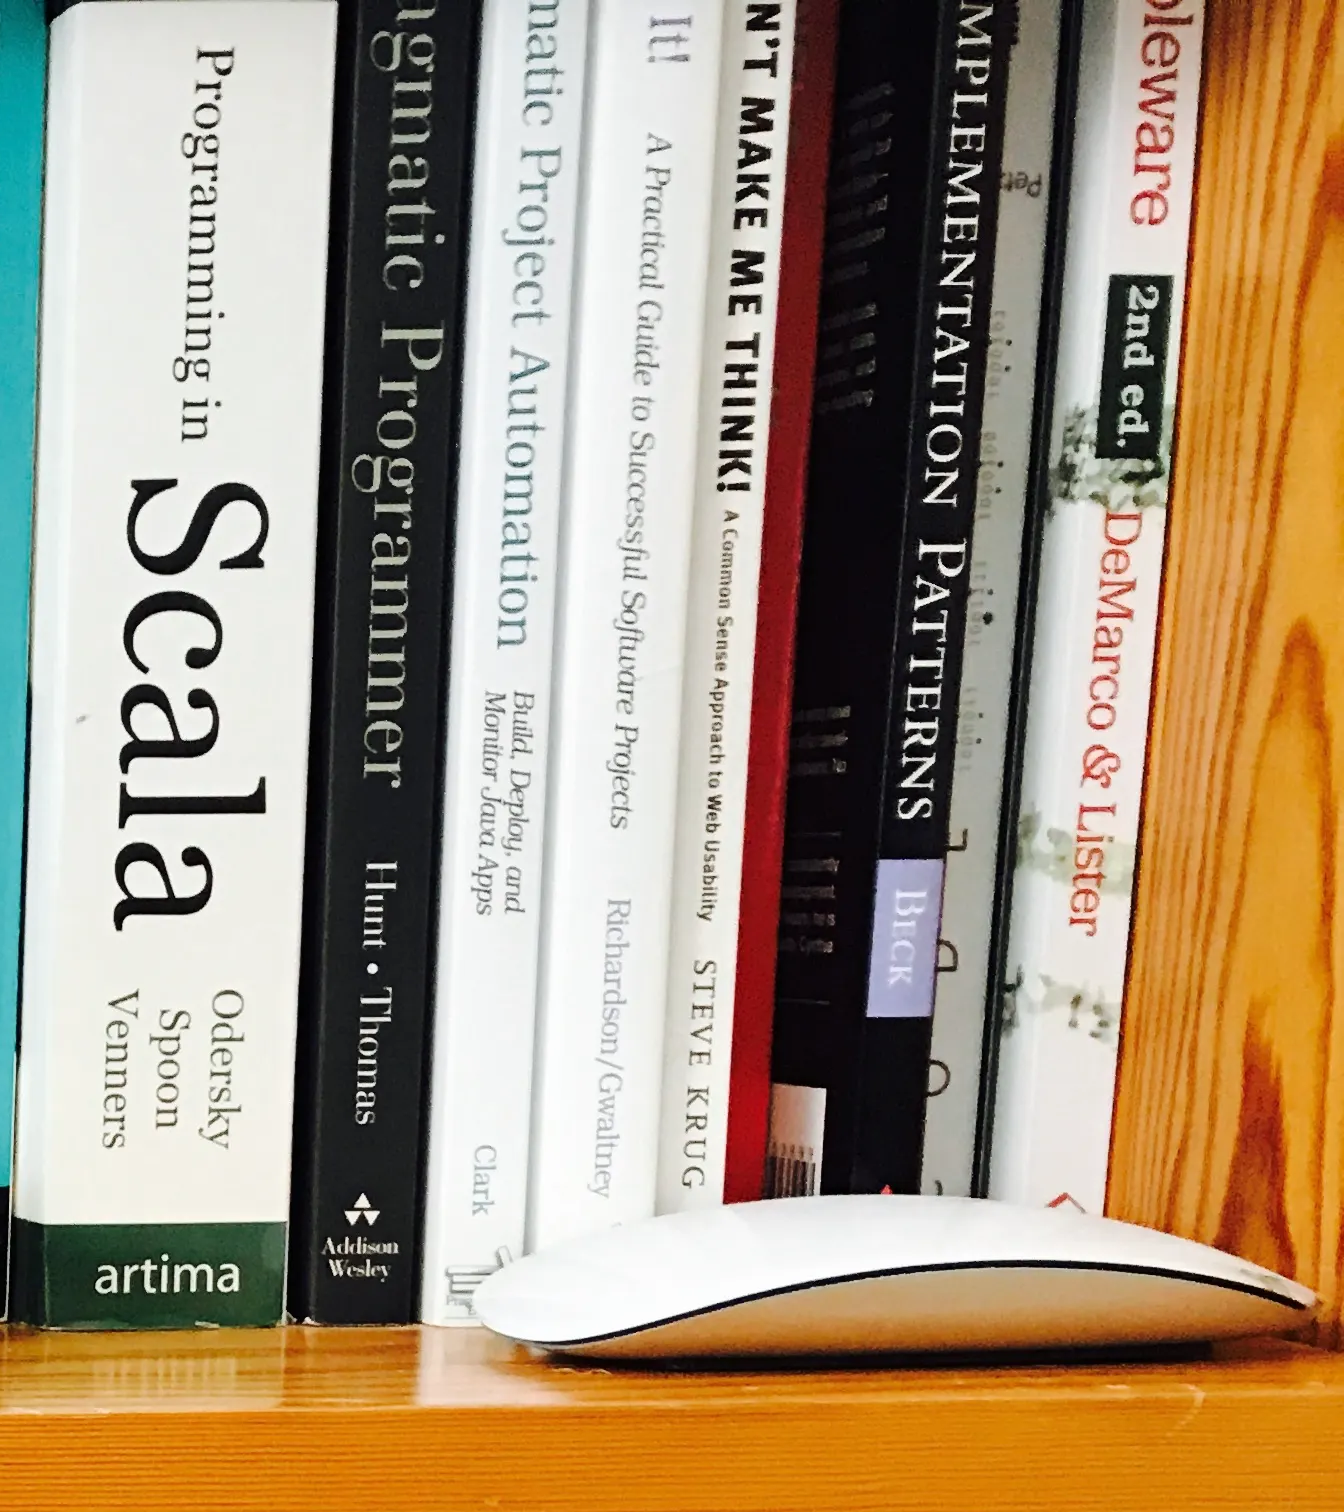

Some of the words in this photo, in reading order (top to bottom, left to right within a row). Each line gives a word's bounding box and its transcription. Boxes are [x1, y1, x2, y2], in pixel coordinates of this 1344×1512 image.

[647, 15, 692, 64] It!
[743, 2, 780, 77] N'T
[646, 134, 672, 155] A
[733, 97, 774, 230] MAKE
[172, 46, 236, 383] Programming
[501, 146, 562, 327] Project
[638, 165, 671, 291] Practical
[922, 1, 993, 507] MPLEMENTATION
[728, 250, 765, 316] ME
[632, 300, 662, 387] Guide
[181, 399, 222, 442] in
[631, 396, 652, 422] to
[718, 334, 760, 492] THINK!
[495, 347, 550, 649] Automation
[622, 430, 653, 581] Successful
[724, 510, 739, 522] A
[350, 321, 445, 789] Programmer
[720, 529, 739, 609] Common
[612, 590, 646, 714] Software
[716, 616, 733, 672] Sense
[1086, 511, 1143, 730] DeMarco
[112, 477, 270, 932] Scala
[710, 677, 729, 769] Approach
[894, 538, 967, 821] PATTERNS
[484, 691, 506, 784] Monitor
[514, 691, 535, 764] Build,
[1082, 742, 1121, 789] &
[481, 788, 498, 848] Java
[506, 770, 532, 859] Deploy,
[610, 722, 638, 829] Projects
[706, 794, 720, 834] Web
[710, 774, 721, 789] to
[476, 855, 494, 916] Apps
[504, 864, 525, 913] and
[696, 838, 720, 922] Usability
[1068, 801, 1107, 938] Lister
[587, 898, 632, 1200] Richardson/Gwaltney
[687, 959, 716, 1066] STEVE
[682, 1086, 708, 1189] KRUG
